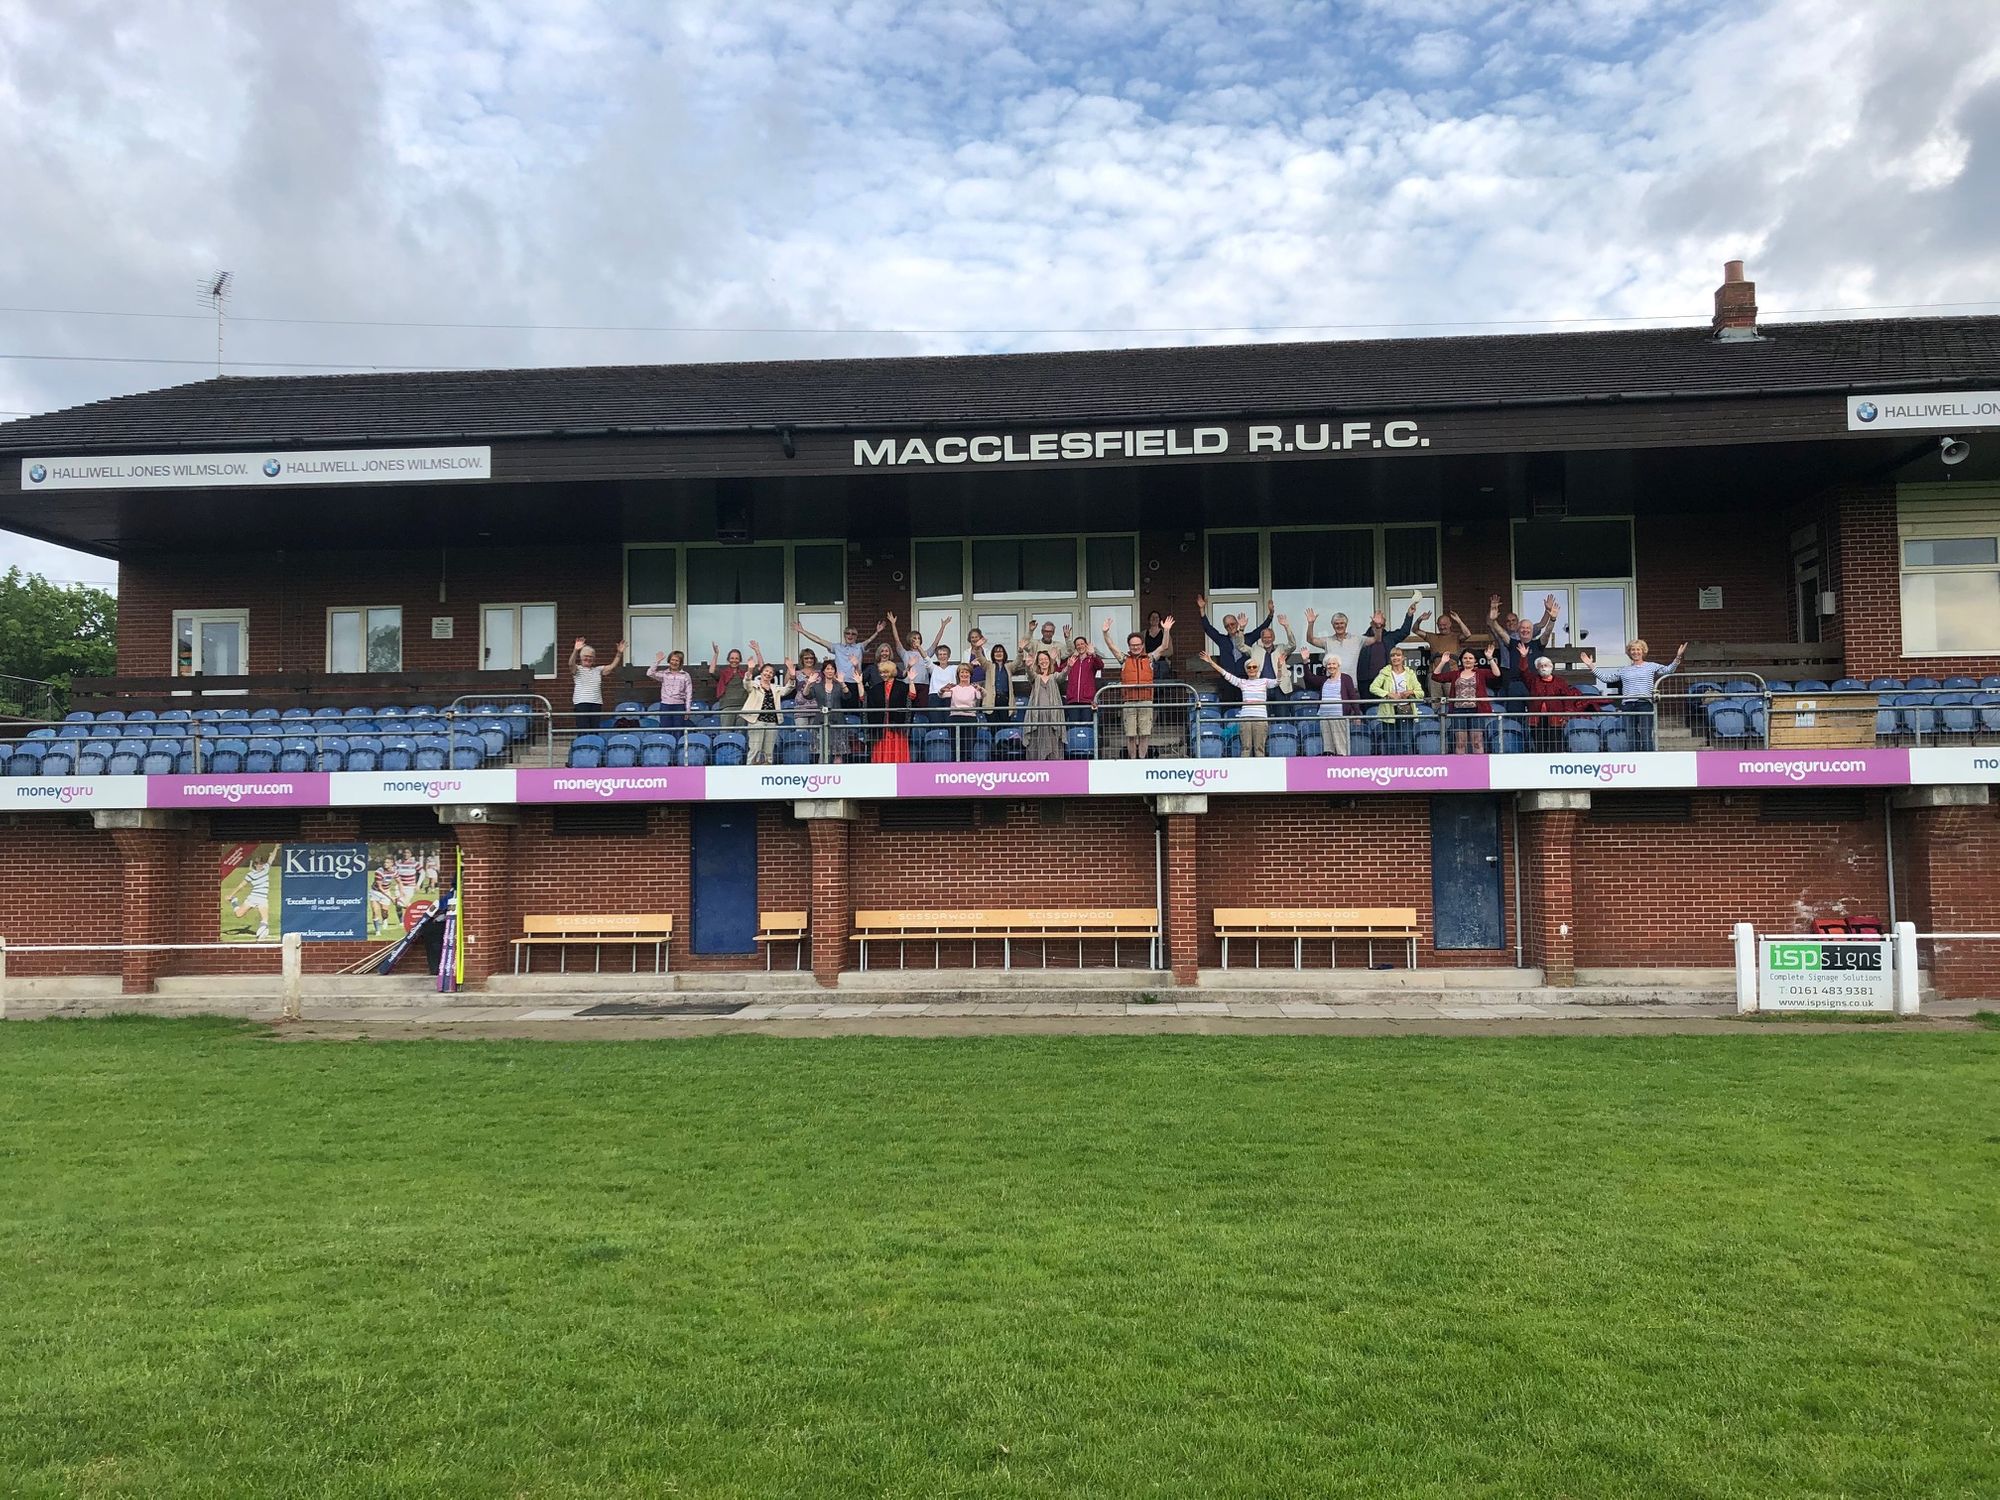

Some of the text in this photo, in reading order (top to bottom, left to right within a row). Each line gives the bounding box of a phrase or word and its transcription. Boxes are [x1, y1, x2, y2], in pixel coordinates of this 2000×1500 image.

[1885, 404, 1970, 418] HALLIWELL
[853, 420, 1430, 466] MACCLESFIELD R.U.F.C.
[53, 463, 248, 479] HALLIWELL JONES WILMSLOW.
[286, 457, 483, 474] HALLIWELL JONES WILMSLOW.
[1145, 767, 1228, 787] moneyguru
[1327, 764, 1448, 786] moneyguru.com
[1549, 761, 1636, 782] moneyguru
[1739, 758, 1866, 781] moneyguru.com
[383, 779, 461, 798] moneyguru
[553, 776, 667, 797] moneyguru.com
[761, 773, 841, 792] moneyguru
[935, 770, 1050, 791] moneyguru.com
[17, 784, 94, 803] moneyguru
[183, 782, 293, 803] moneyguru.com
[285, 849, 366, 879] King's
[556, 917, 640, 925] SCISSORWOOD
[899, 912, 984, 920] SCISSORWOOD
[1027, 911, 1114, 919] SCISSORWOOD
[1270, 910, 1360, 919] SCISSORWOOD
[1770, 973, 1881, 982] Complete Signage Solutions
[1790, 986, 1818, 995] 0161
[1821, 986, 1842, 995] 483
[1845, 987, 1873, 995] 9381
[1778, 999, 1874, 1008] www.ispsigns.co.uk
